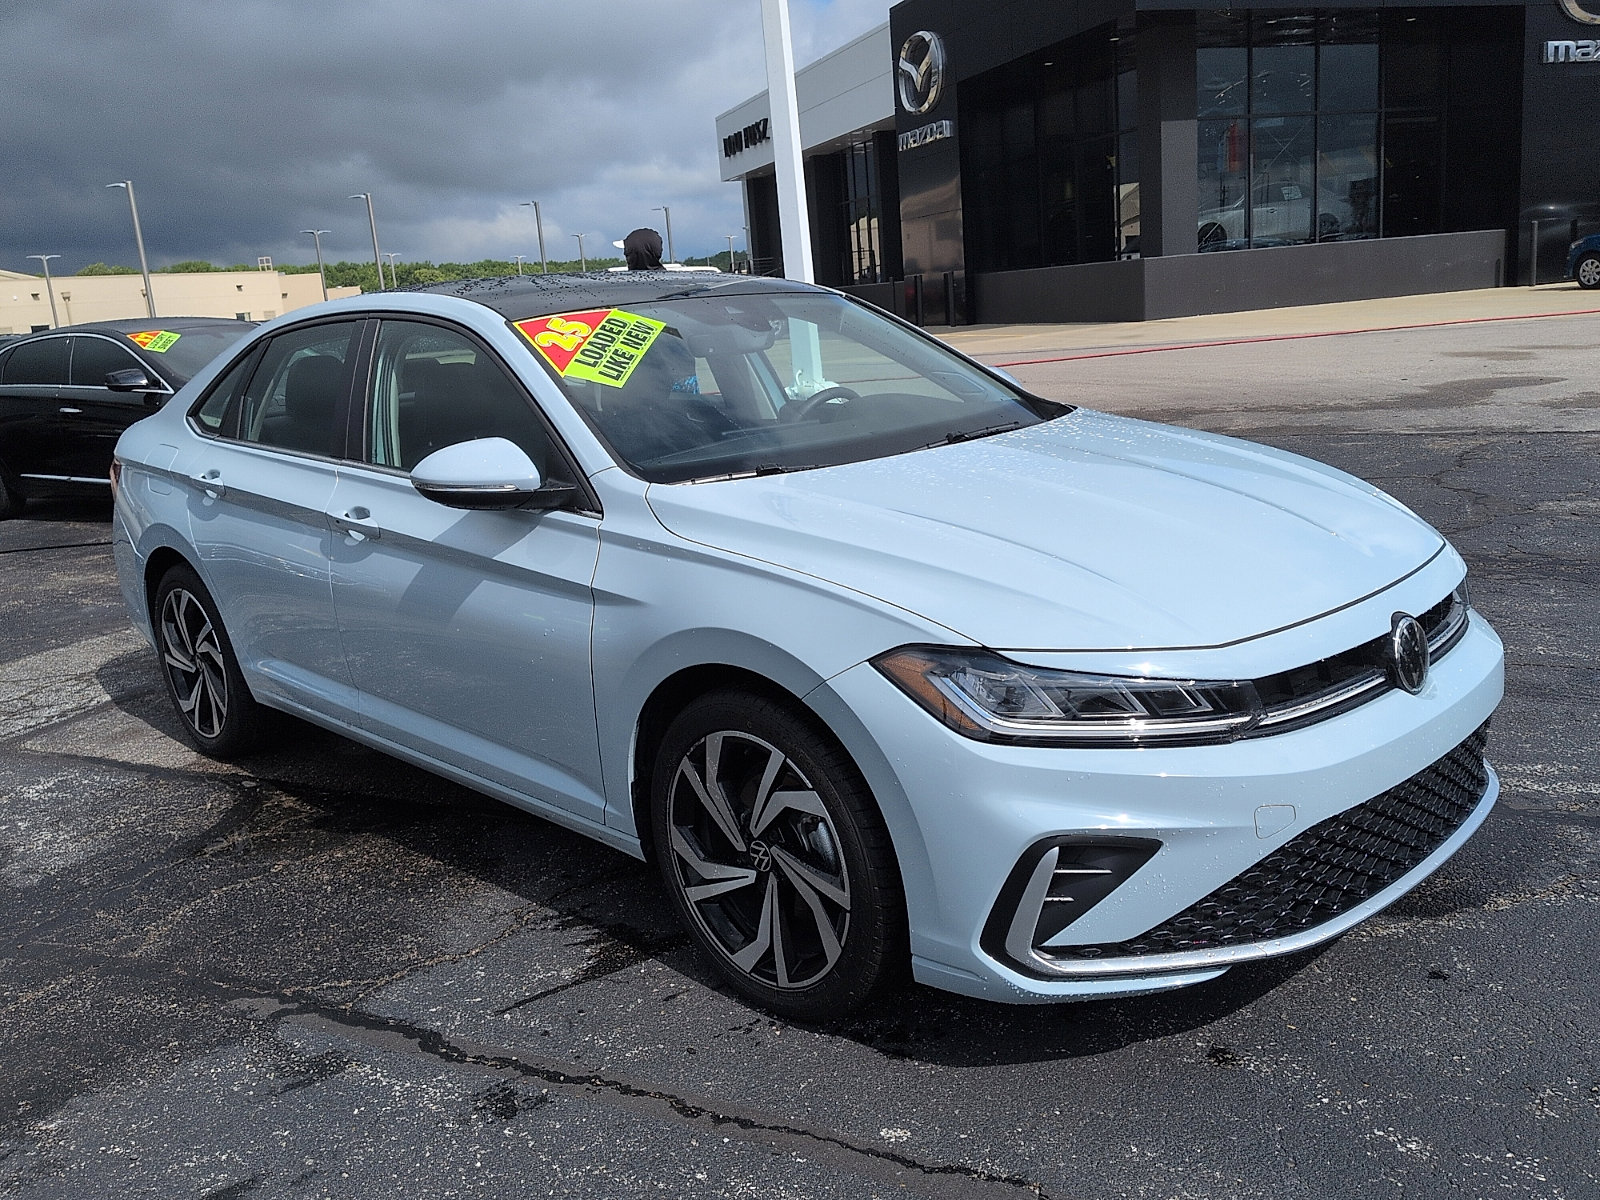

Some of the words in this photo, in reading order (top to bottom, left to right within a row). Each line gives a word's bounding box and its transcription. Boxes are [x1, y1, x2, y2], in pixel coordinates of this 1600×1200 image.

[898, 120, 953, 151] mazda
[534, 317, 592, 351] 25
[574, 317, 630, 368] LOADED
[598, 348, 638, 381] LIKE
[620, 320, 657, 350] NEW
